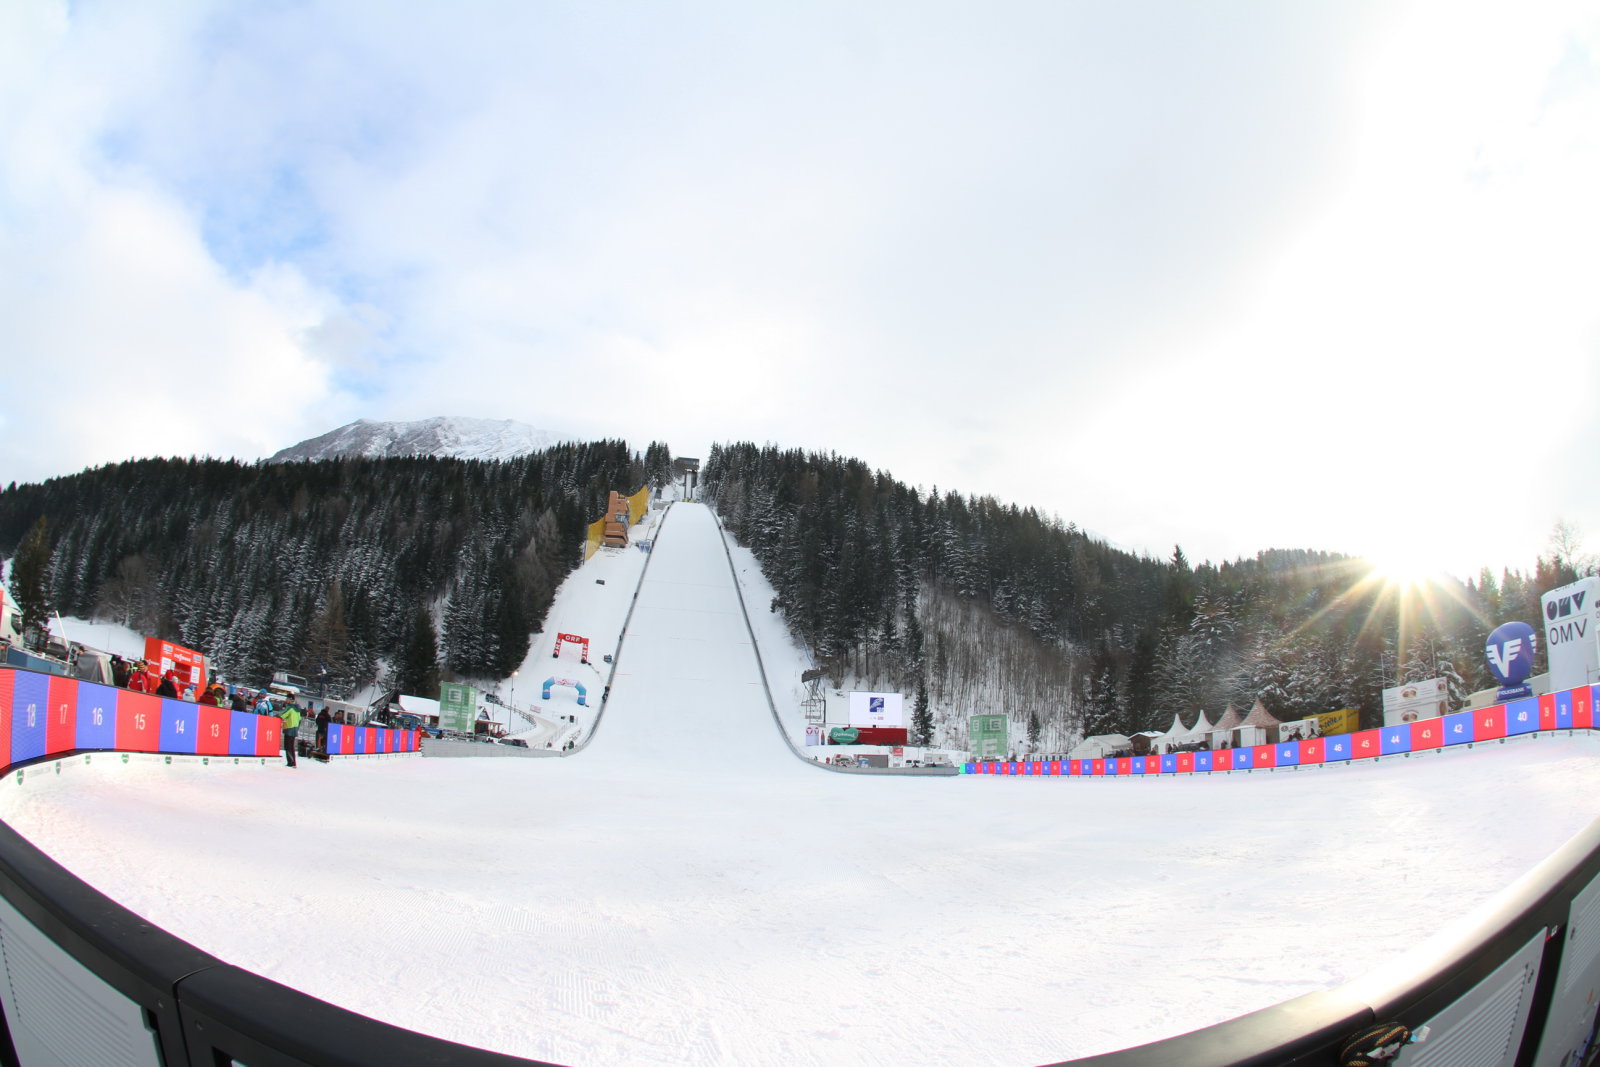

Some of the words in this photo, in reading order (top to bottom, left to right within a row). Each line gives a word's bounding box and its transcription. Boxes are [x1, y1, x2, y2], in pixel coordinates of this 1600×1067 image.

[1546, 590, 1586, 620] OMV
[1550, 618, 1587, 645] OMV
[27, 703, 36, 728] 18
[60, 704, 68, 724] 17
[92, 707, 103, 726] 16
[1518, 711, 1528, 721] 40
[134, 713, 146, 730] 15
[175, 719, 185, 734] 14
[1484, 718, 1493, 727] 41
[210, 724, 219, 737] 13
[240, 728, 248, 740] 12
[1421, 729, 1431, 738] 43
[1454, 724, 1463, 733] 42
[266, 730, 273, 742] 11
[1391, 735, 1400, 744] 44
[1334, 743, 1342, 752] 46
[1361, 739, 1370, 748] 45
[1260, 752, 1268, 760] 49
[1283, 750, 1292, 758] 48
[1307, 747, 1316, 755] 47
